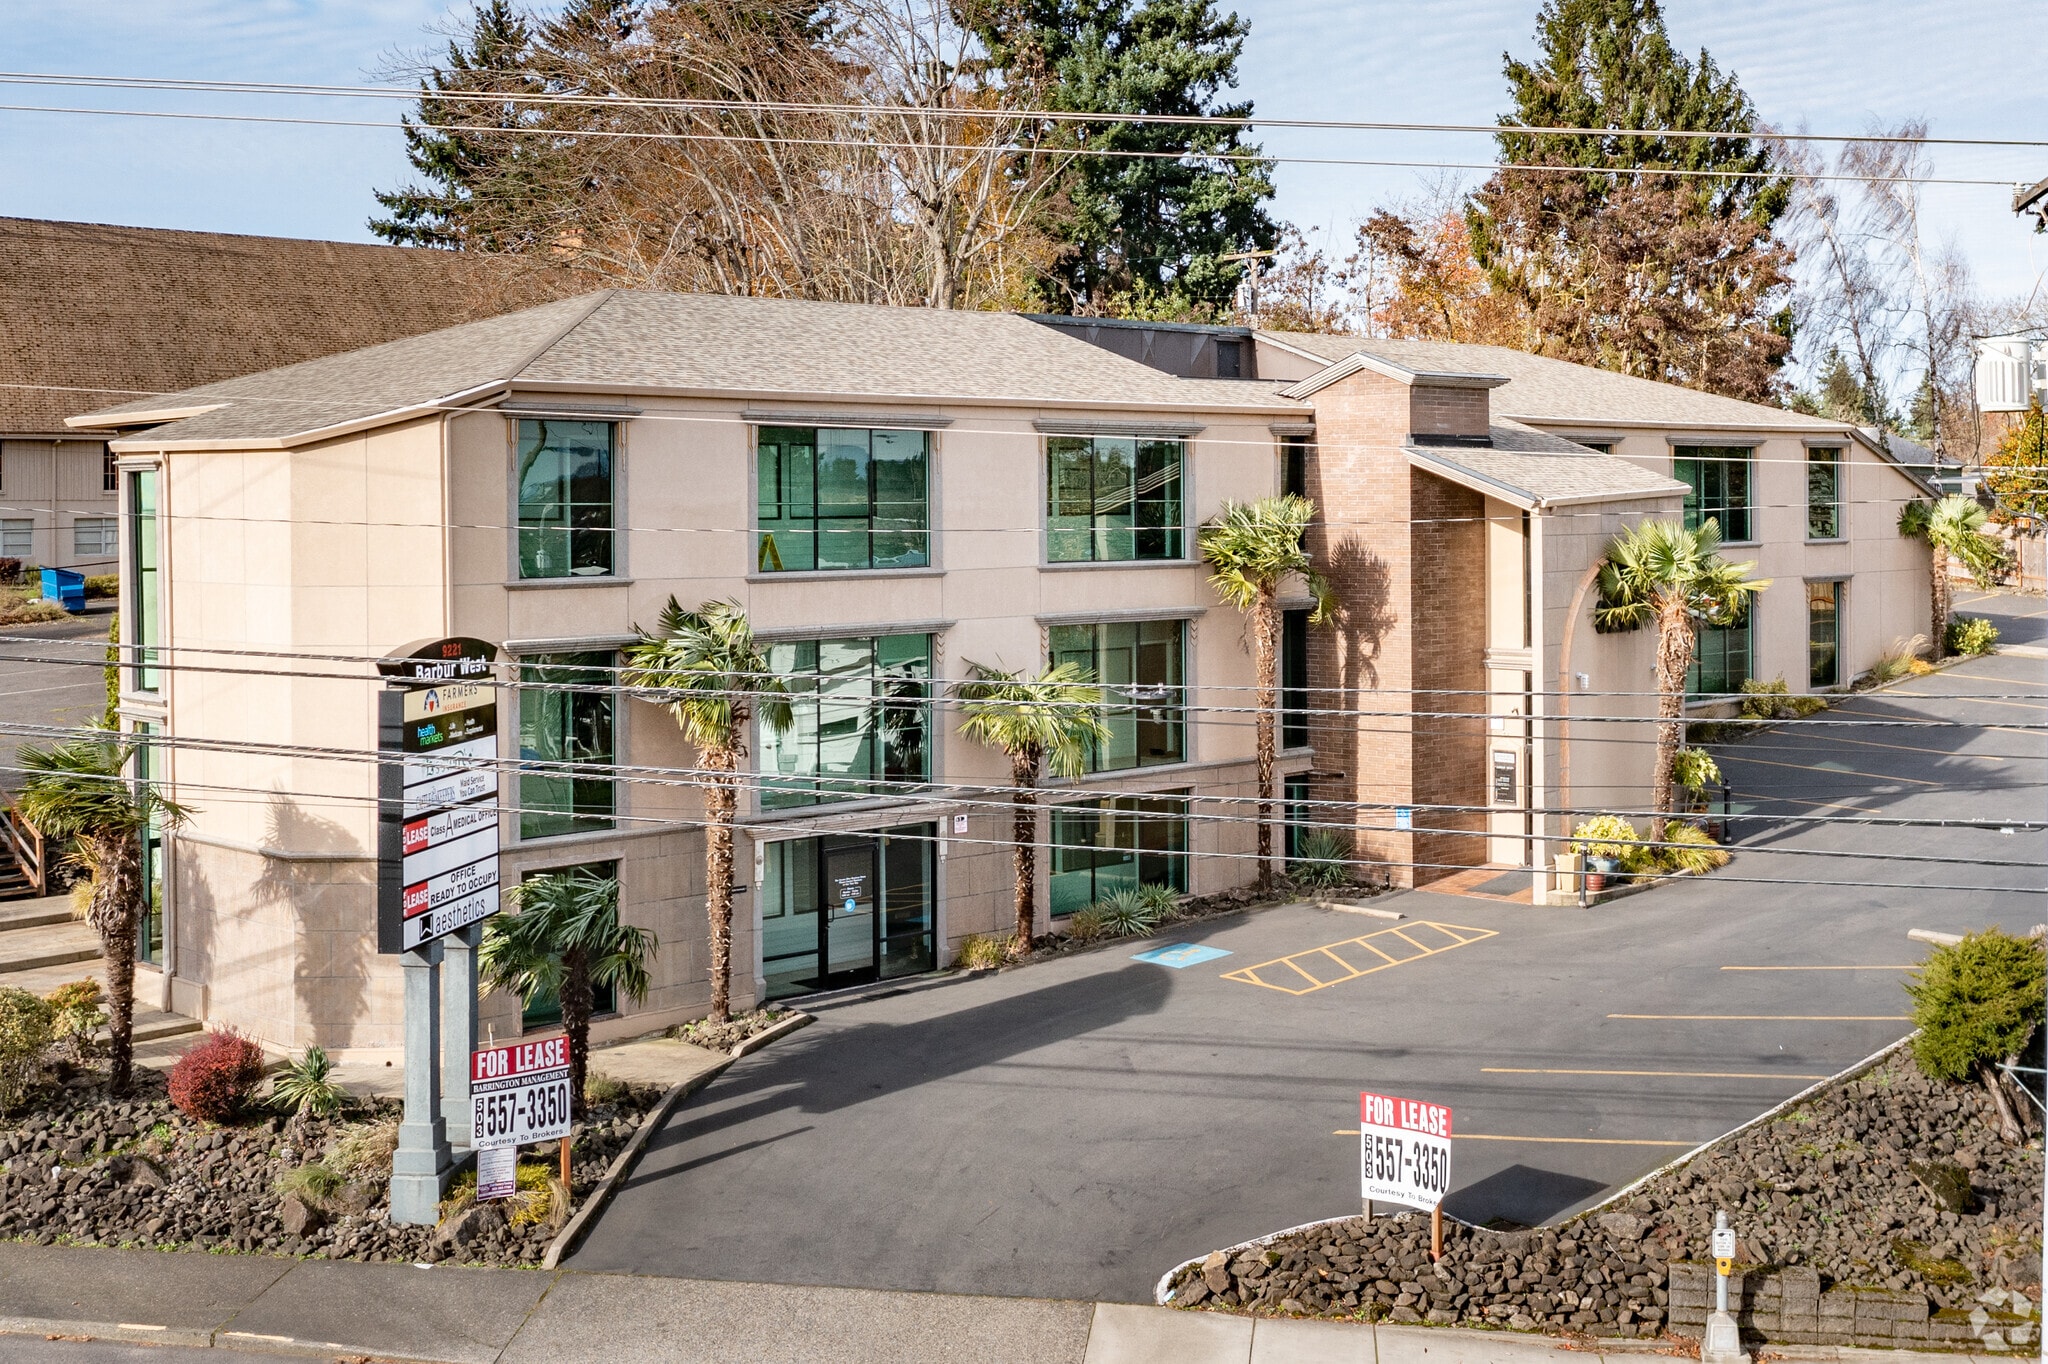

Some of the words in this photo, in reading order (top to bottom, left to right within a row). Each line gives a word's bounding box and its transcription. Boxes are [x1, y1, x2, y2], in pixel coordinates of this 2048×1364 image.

[442, 643, 462, 657] 9221
[416, 663, 456, 679] Barbur
[460, 655, 487, 675] West
[443, 684, 478, 700] FARMERS
[417, 723, 436, 738] health
[420, 732, 444, 746] markets
[406, 826, 428, 845] LEASE
[431, 825, 446, 837] Class
[445, 813, 454, 838] A
[454, 813, 477, 829] MEDICAL
[451, 866, 476, 883] OFFICE
[406, 889, 428, 909] LEASE
[430, 886, 455, 905] READY
[457, 881, 467, 894] TO
[469, 871, 497, 890] OCCUPY
[436, 898, 486, 934] aesthetics
[477, 1050, 508, 1078] FOR
[516, 1039, 565, 1072] LEASE
[473, 1079, 520, 1093] BARRINGTON
[521, 1070, 568, 1086] MANAGEMENT
[487, 1083, 567, 1137] 557-3350
[1365, 1095, 1395, 1126] FOR
[1401, 1101, 1447, 1136] LEASE
[478, 1138, 516, 1148] Courtesy
[532, 1129, 563, 1140] Brokers
[1376, 1136, 1447, 1194] 557-3350
[1369, 1185, 1405, 1199] Courtesy
[1408, 1191, 1416, 1200] To
[1418, 1195, 1437, 1206] Broke
